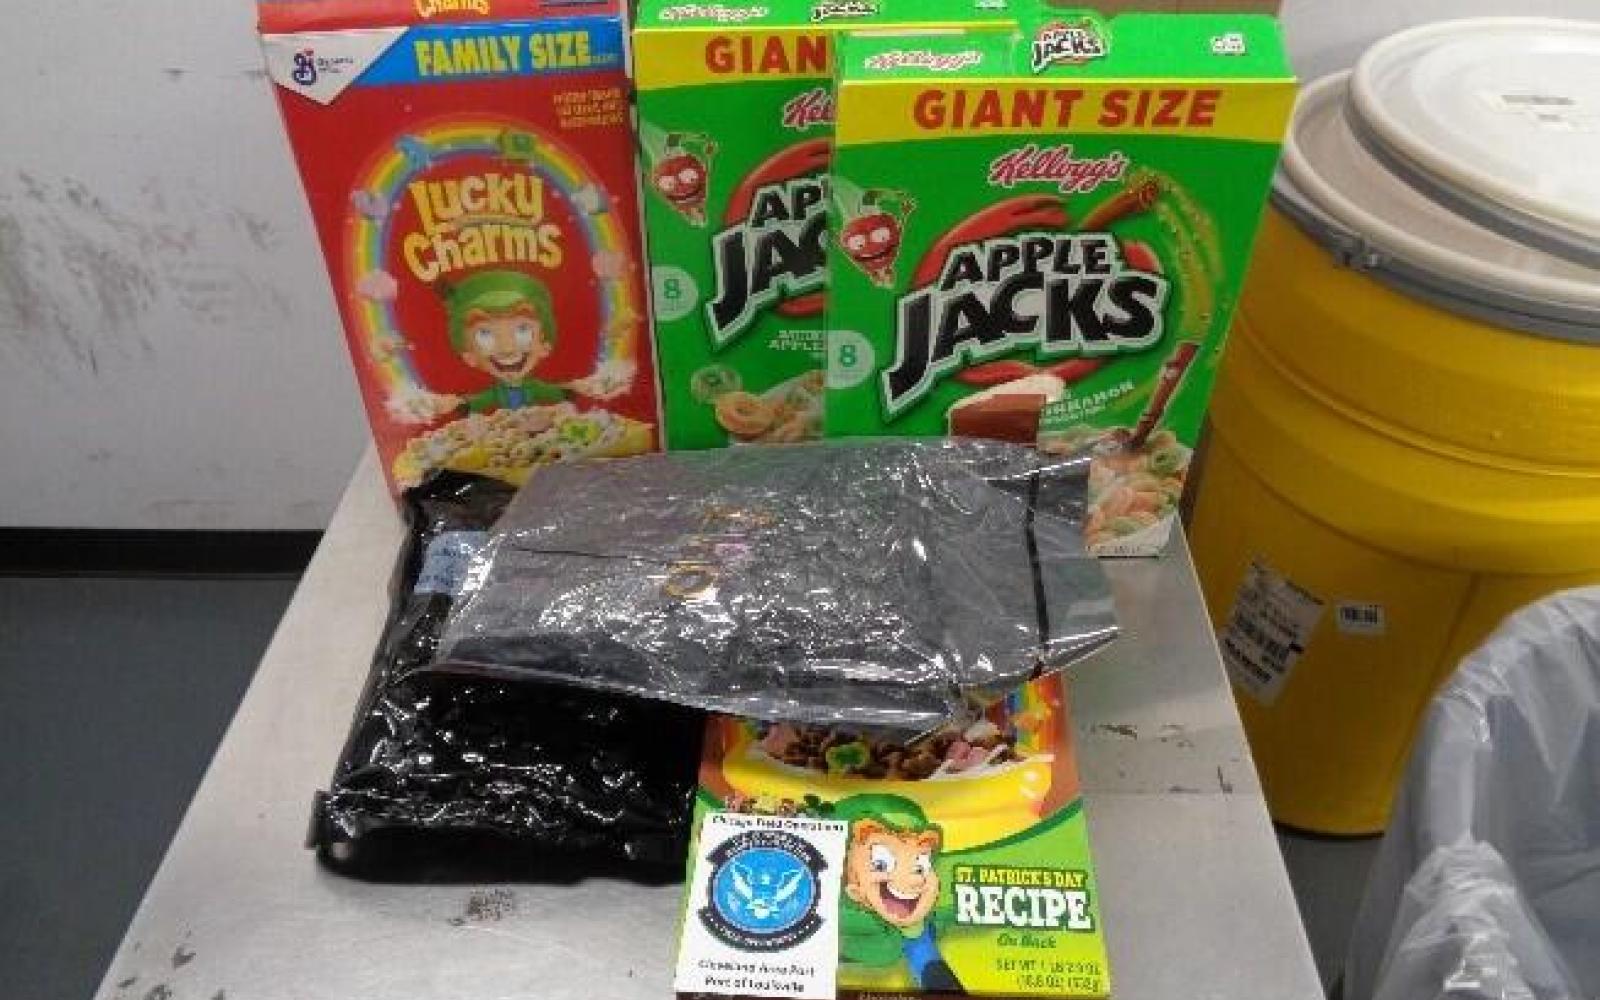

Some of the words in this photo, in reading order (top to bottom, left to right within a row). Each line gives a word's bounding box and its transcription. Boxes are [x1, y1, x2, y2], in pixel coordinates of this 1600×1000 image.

[414, 36, 521, 76] FAMILY
[529, 31, 591, 69] SIZE
[705, 35, 828, 75] GIAN
[914, 89, 1083, 129] GIANT
[1098, 89, 1222, 128] SIZE
[988, 145, 1129, 193] Kellogg's
[751, 182, 831, 229] AP
[403, 223, 563, 282] Charms
[940, 235, 1116, 291] APPLE
[663, 278, 678, 300] 8
[840, 344, 858, 368] 8
[884, 270, 1168, 405] JACKS
[1055, 870, 1085, 888] DAY
[955, 883, 1092, 930] RECIPE
[705, 976, 731, 987] Port
[734, 977, 747, 988] of
